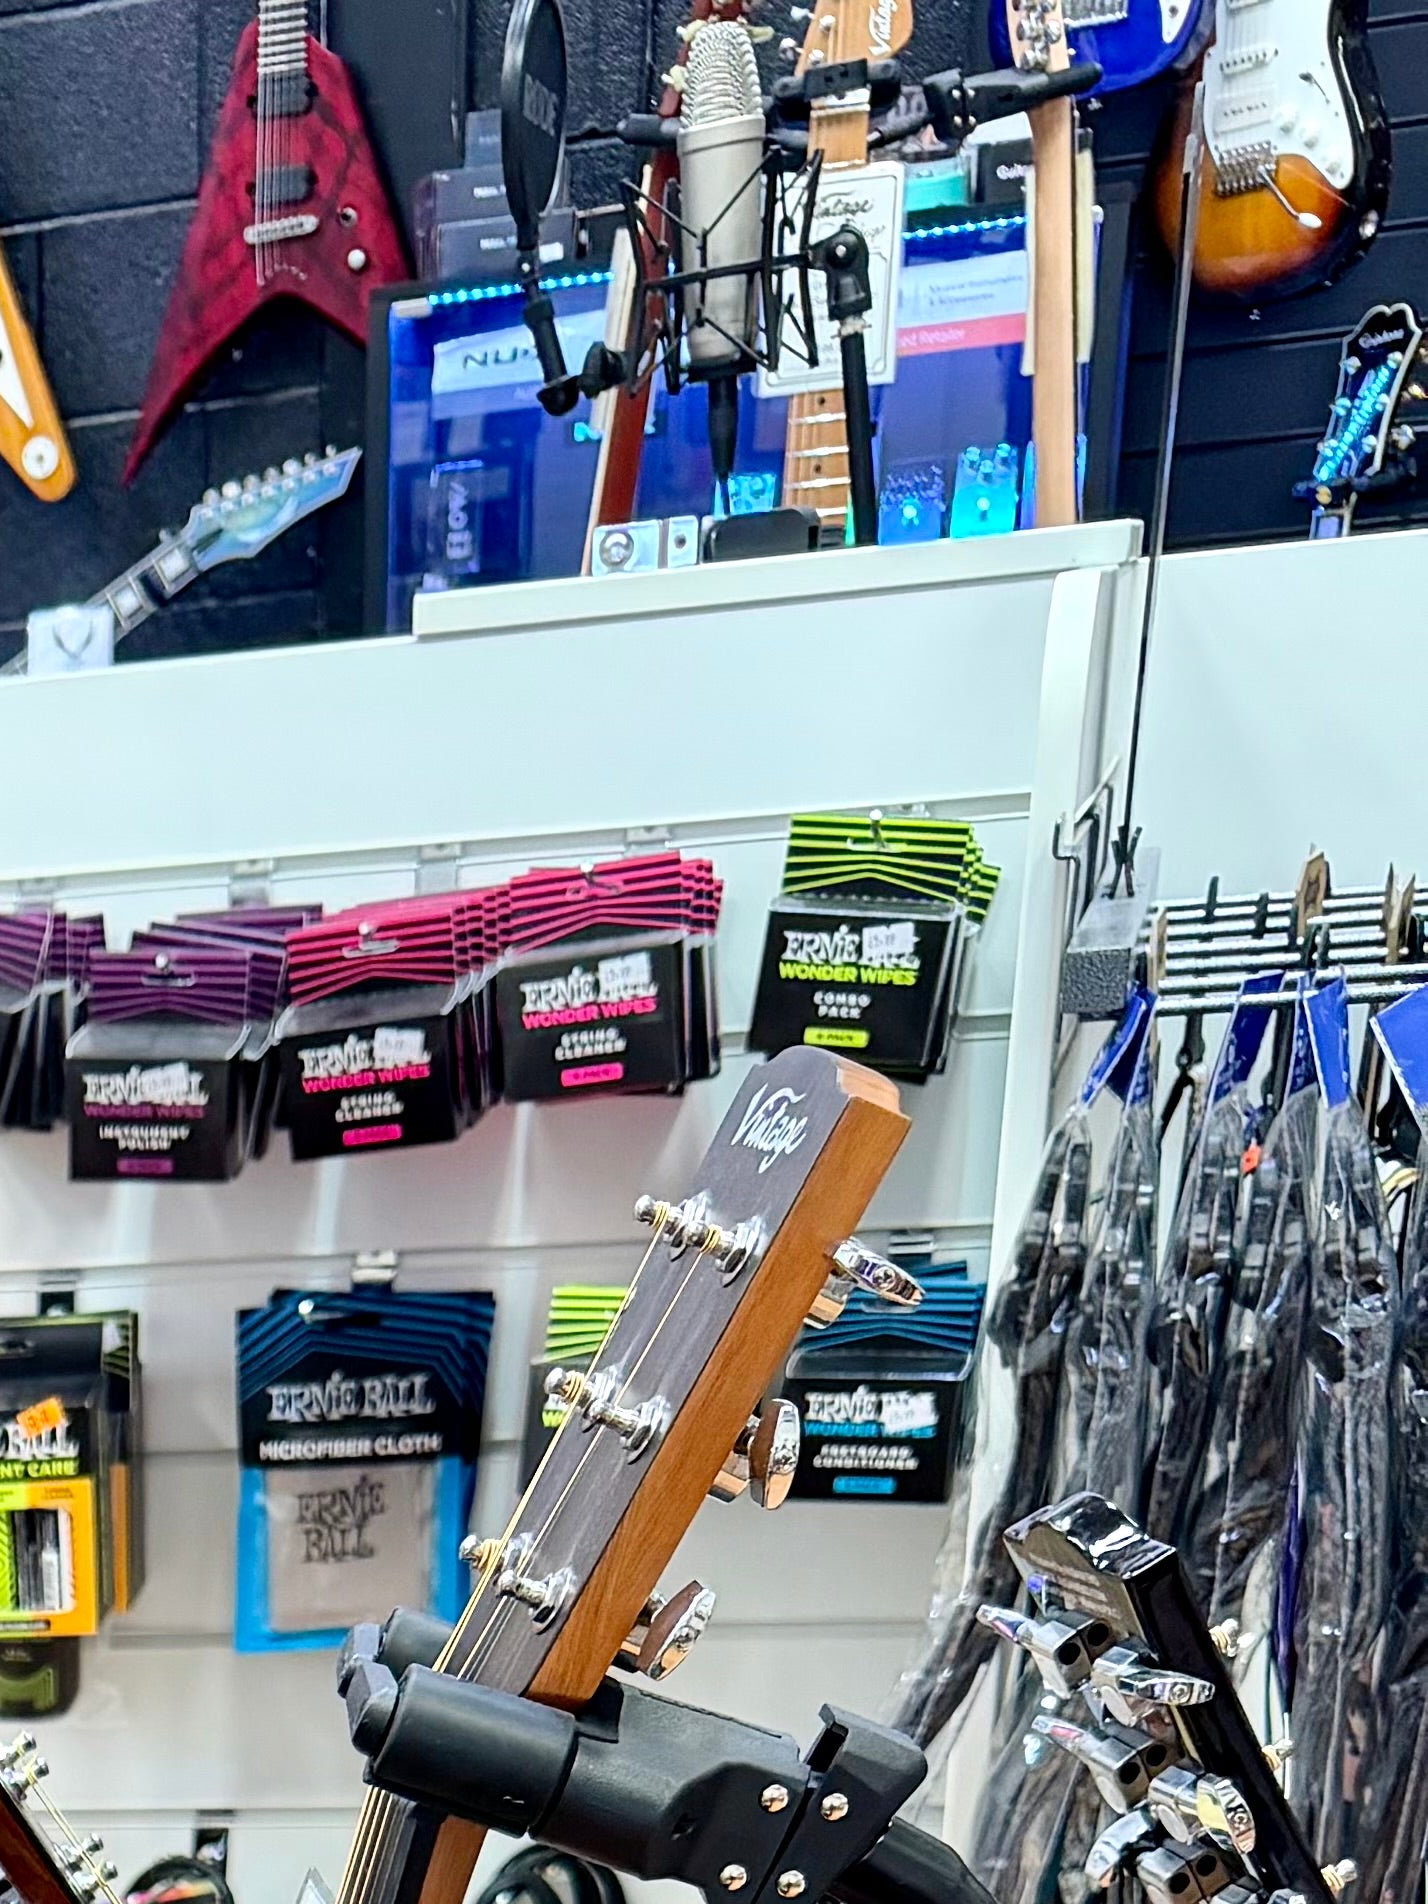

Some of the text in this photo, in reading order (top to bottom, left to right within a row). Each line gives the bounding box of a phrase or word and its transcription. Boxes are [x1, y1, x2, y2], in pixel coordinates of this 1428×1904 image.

[781, 924, 860, 966] ERNIE
[519, 965, 597, 1013] ERNIE
[779, 961, 858, 984] WONDER
[860, 967, 918, 986] WIPES
[522, 997, 657, 1030] WONDER WIPES
[813, 991, 872, 1008] COMBO
[818, 1004, 862, 1020] PACK
[302, 1064, 430, 1093] WONDER WIPES
[731, 1082, 808, 1174] Vintage
[266, 1369, 437, 1423] ERNIE BALL
[259, 1433, 443, 1461] MICROFIBER CLOTH
[28, 1459, 80, 1478] CARE
[295, 1473, 385, 1525] ERNIE
[302, 1524, 374, 1564] BALL
